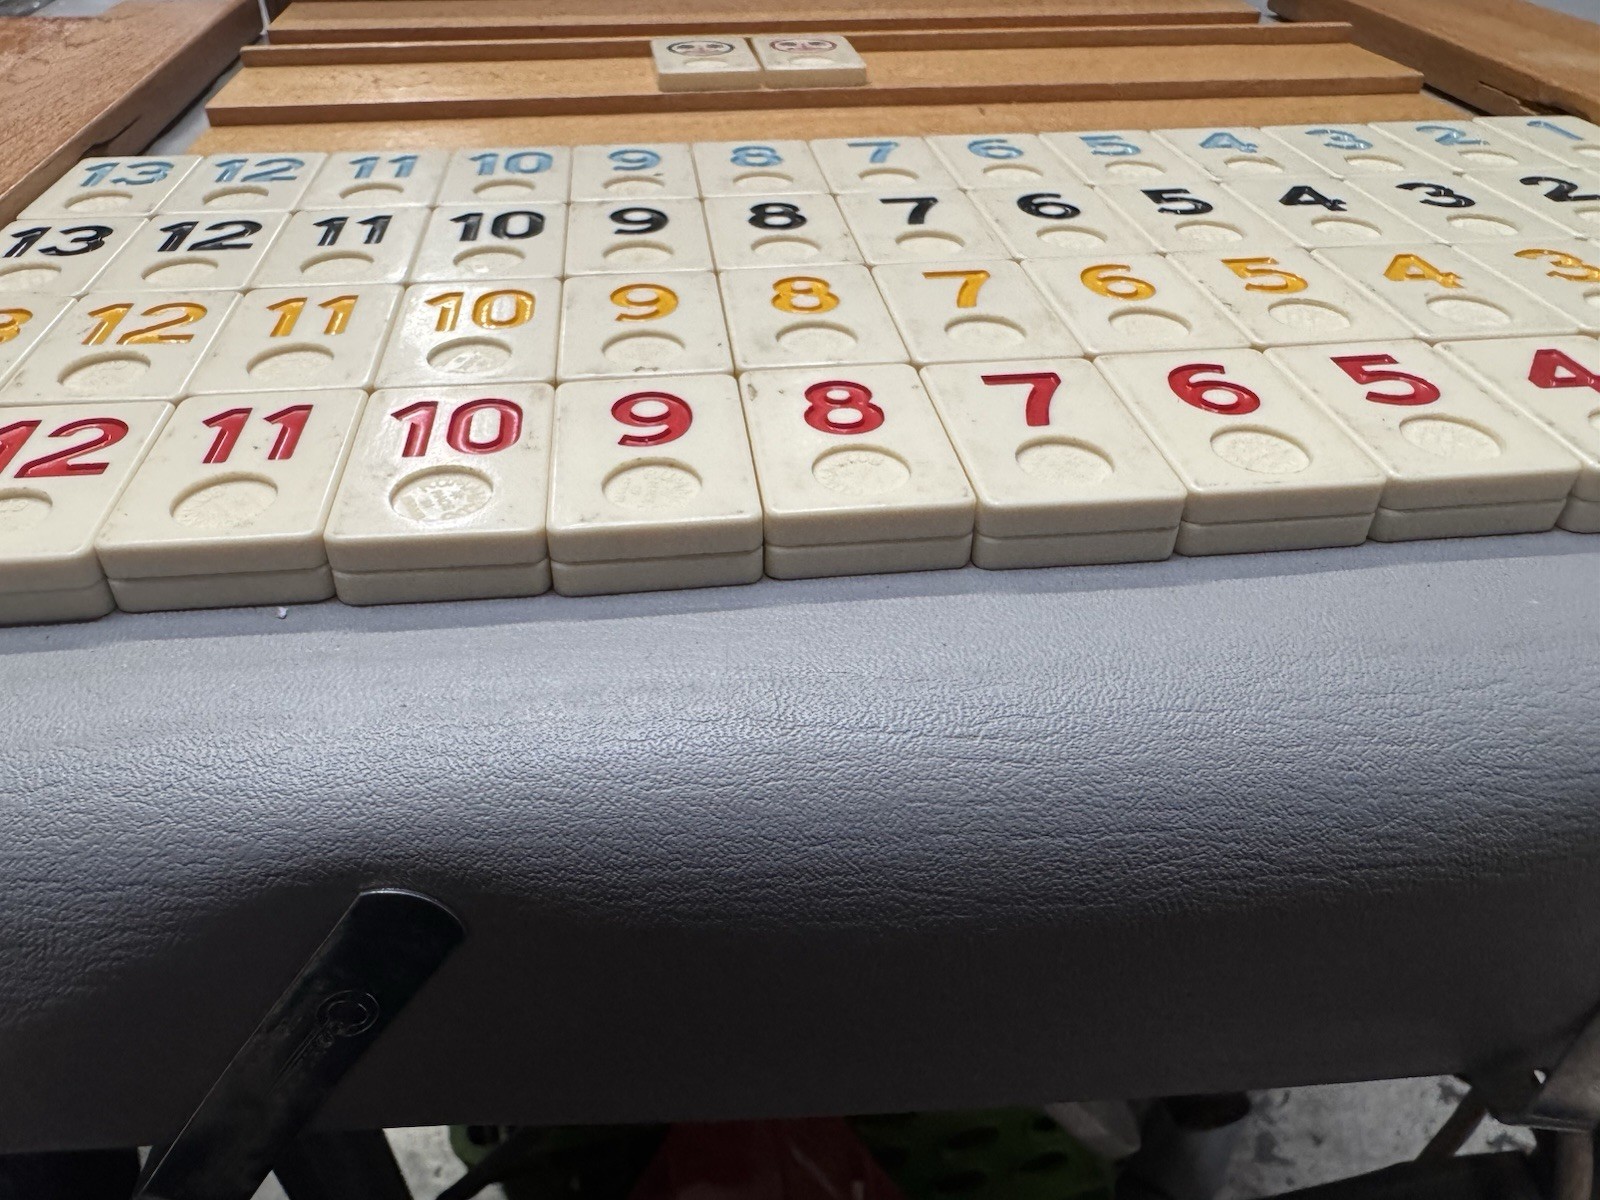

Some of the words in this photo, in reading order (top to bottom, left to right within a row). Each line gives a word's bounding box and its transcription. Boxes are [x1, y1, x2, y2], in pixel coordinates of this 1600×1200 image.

[1079, 135, 1141, 156] 5
[1199, 132, 1258, 153] 4
[1306, 128, 1373, 150] 3
[1415, 125, 1490, 146] 2
[1526, 120, 1584, 141] 1
[469, 151, 553, 175] 10
[607, 149, 661, 170] 9
[730, 146, 784, 167] 8
[848, 142, 899, 163] 7
[967, 139, 1024, 159] 6
[80, 160, 175, 186] 13
[214, 157, 305, 183] 12
[349, 154, 419, 179] 11
[1141, 188, 1214, 215] 5
[1279, 185, 1347, 211] 4
[1396, 181, 1475, 208] 3
[1520, 176, 1600, 202] 2
[609, 207, 669, 234] 9
[748, 202, 807, 230] 8
[879, 197, 939, 224] 7
[1016, 192, 1081, 219] 6
[2, 224, 113, 257] 13
[158, 219, 262, 252] 12
[313, 215, 393, 246] 11
[451, 210, 545, 241] 10
[1221, 257, 1309, 294] 5
[1383, 253, 1465, 289] 4
[1514, 248, 1600, 282] 3
[771, 275, 839, 314] 8
[922, 269, 991, 308] 7
[1080, 263, 1157, 301] 6
[267, 295, 358, 337] 11
[426, 289, 535, 331] 10
[609, 283, 679, 322] 9
[81, 302, 208, 345] 12
[1167, 363, 1260, 415] 6
[1330, 353, 1441, 406] 5
[803, 380, 885, 435] 8
[981, 372, 1062, 427] 7
[202, 404, 314, 464] 11
[391, 398, 524, 457] 10
[611, 391, 694, 446] 9
[0, 417, 129, 478] 12
